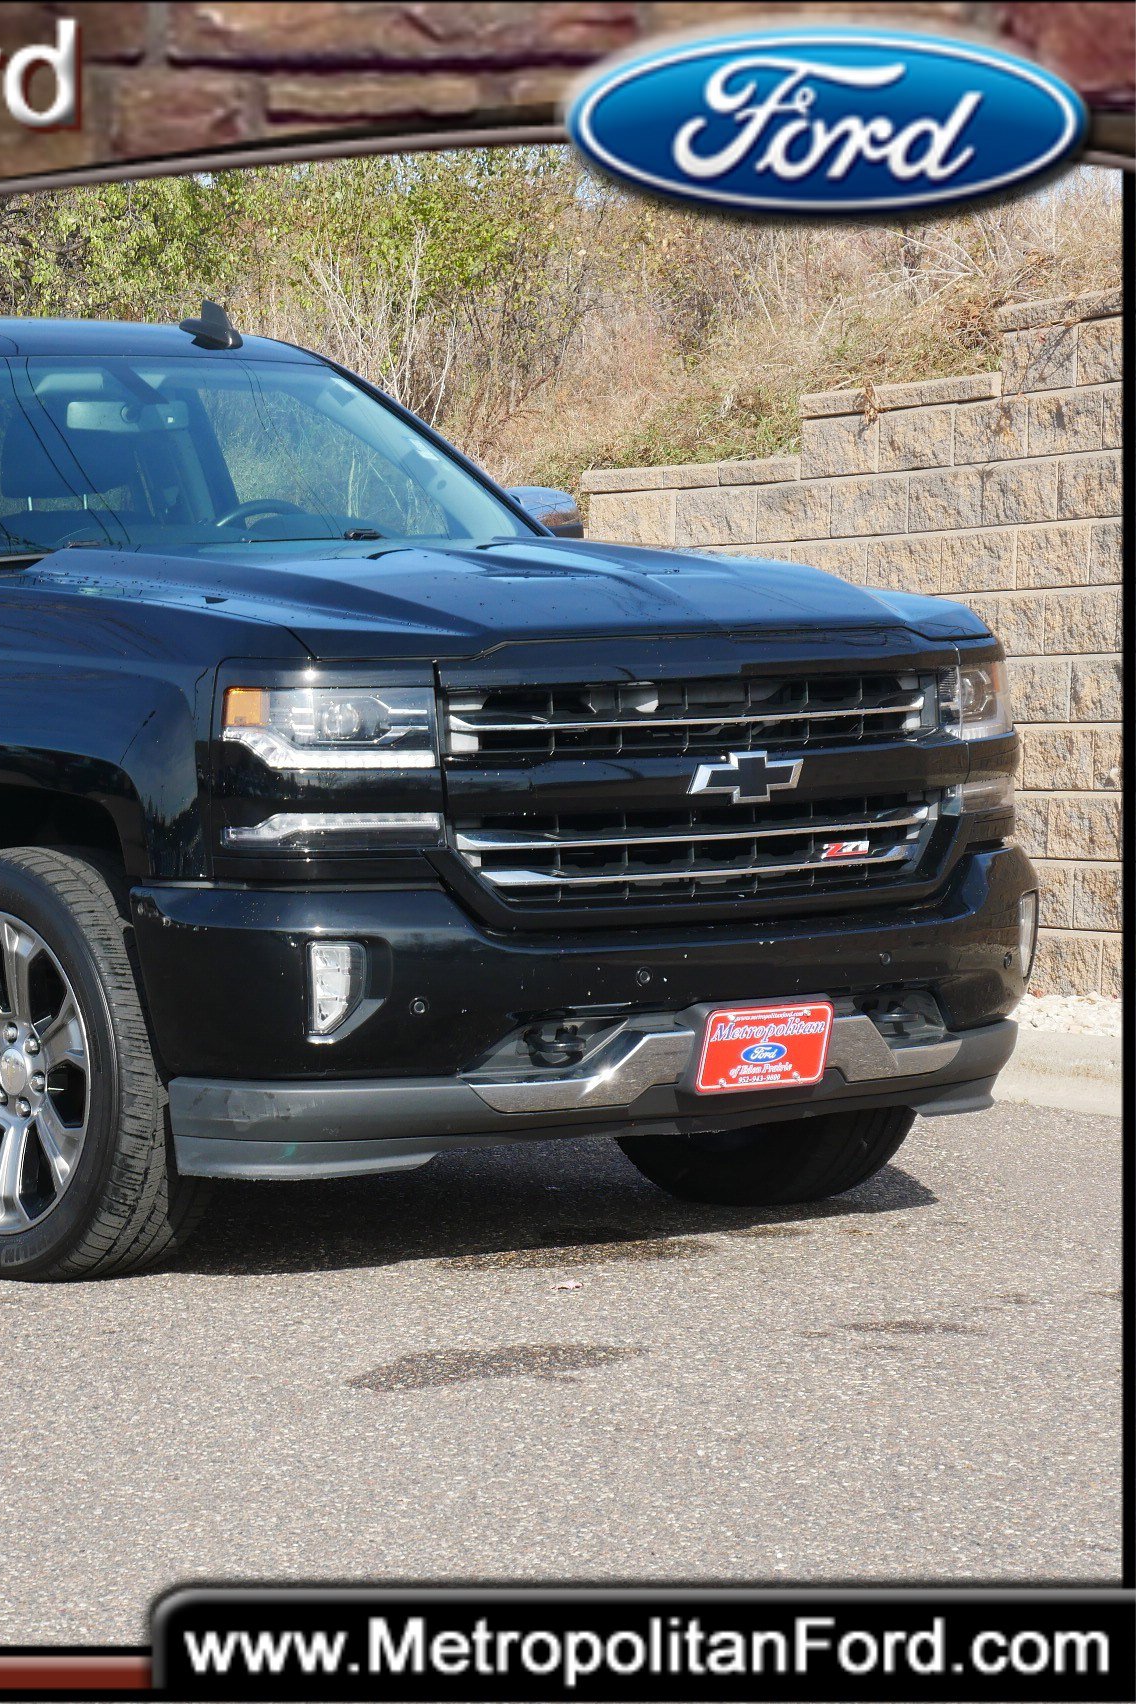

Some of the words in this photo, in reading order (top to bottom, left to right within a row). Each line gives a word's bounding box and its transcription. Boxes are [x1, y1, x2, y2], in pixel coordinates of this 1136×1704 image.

[821, 840, 870, 859] Z71
[711, 1017, 825, 1042] Metropolitan
[750, 1046, 778, 1060] Ford
[729, 1065, 741, 1078] of
